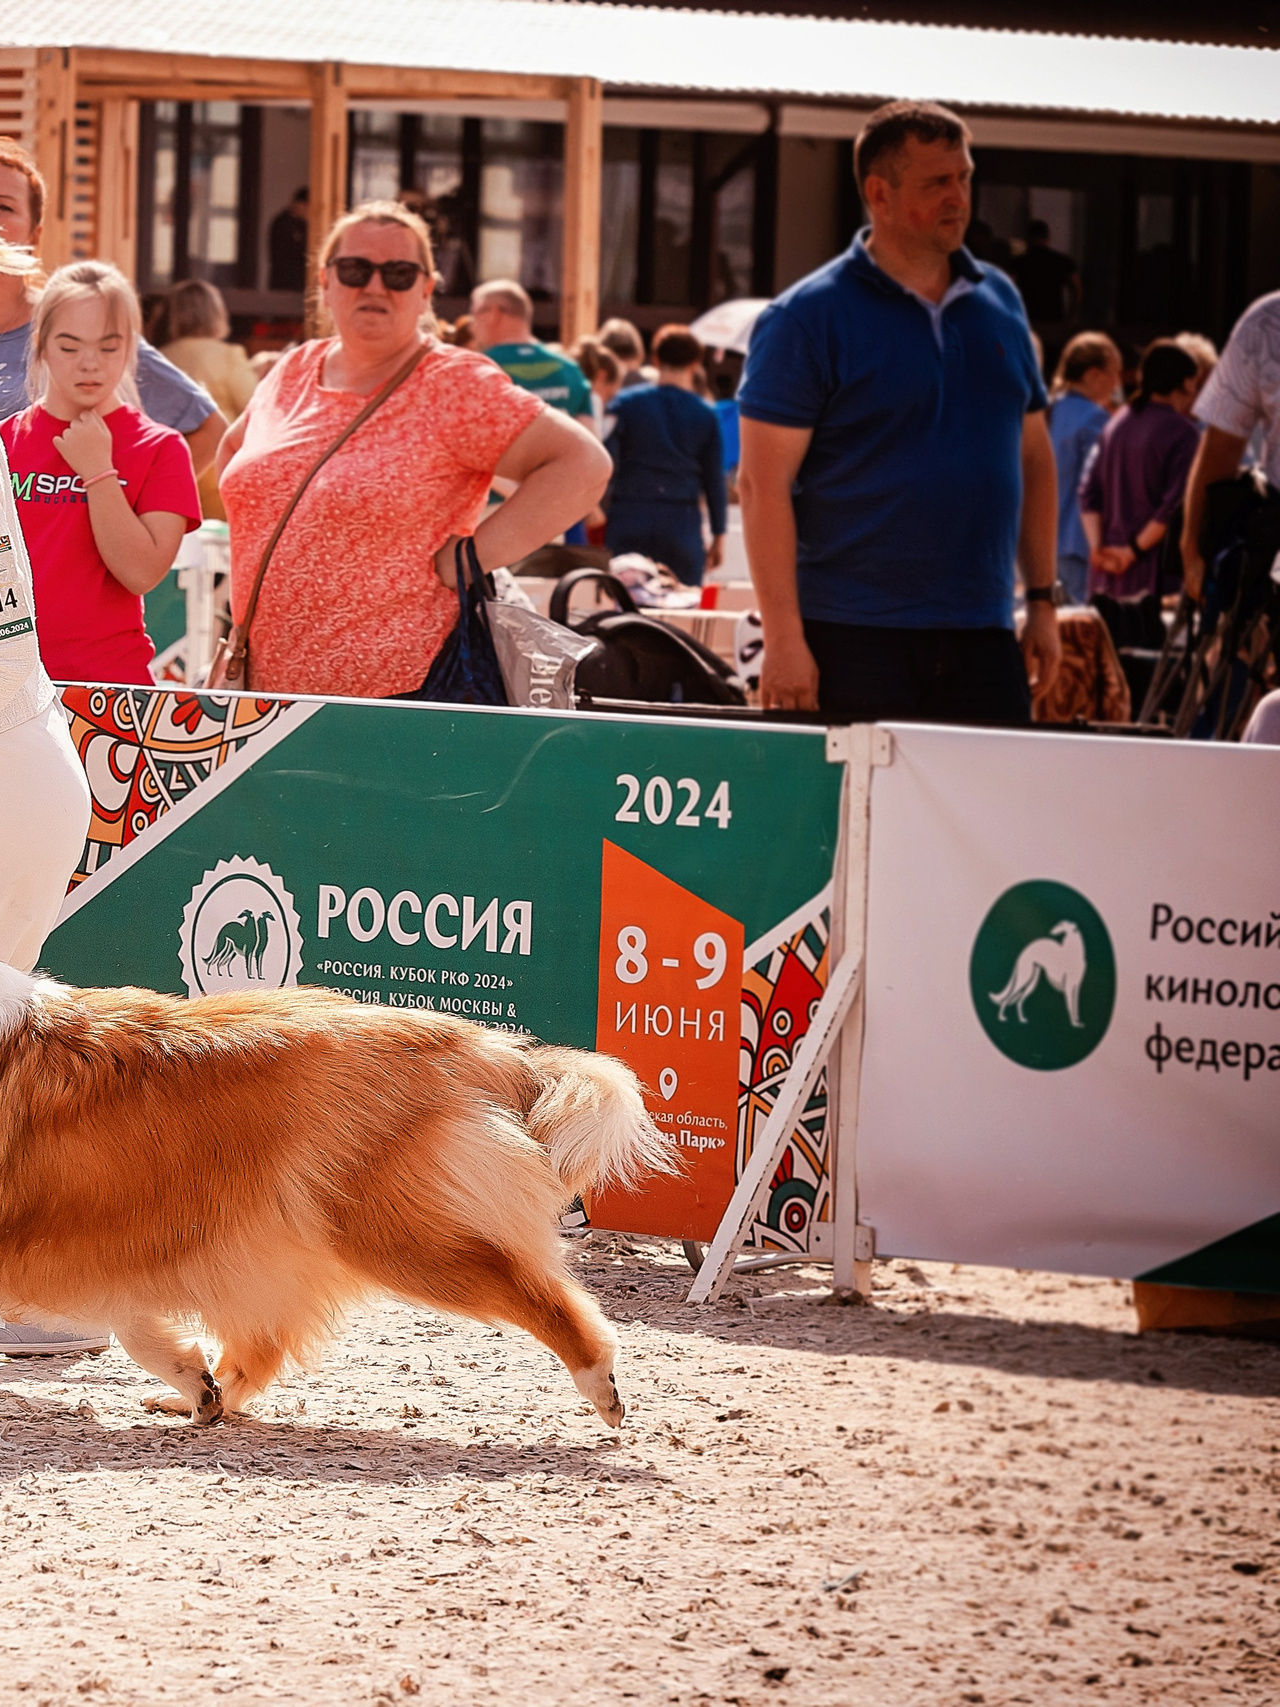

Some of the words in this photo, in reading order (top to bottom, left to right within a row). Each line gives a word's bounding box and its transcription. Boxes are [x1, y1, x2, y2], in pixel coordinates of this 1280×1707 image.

[615, 773, 732, 829] 2024
[317, 884, 533, 956] РОССИЯ
[316, 959, 386, 980] «РОССИЯ.
[389, 966, 437, 985] КУБОК
[440, 971, 470, 987] РКФ
[473, 973, 514, 990] 2024»
[388, 991, 436, 1010] КУБОК
[439, 996, 502, 1016] МОСКВЫ
[506, 1002, 517, 1018] &
[616, 1001, 725, 1042] ИЮНЯ
[676, 1110, 728, 1130] область,
[680, 1129, 726, 1153] Парк»
